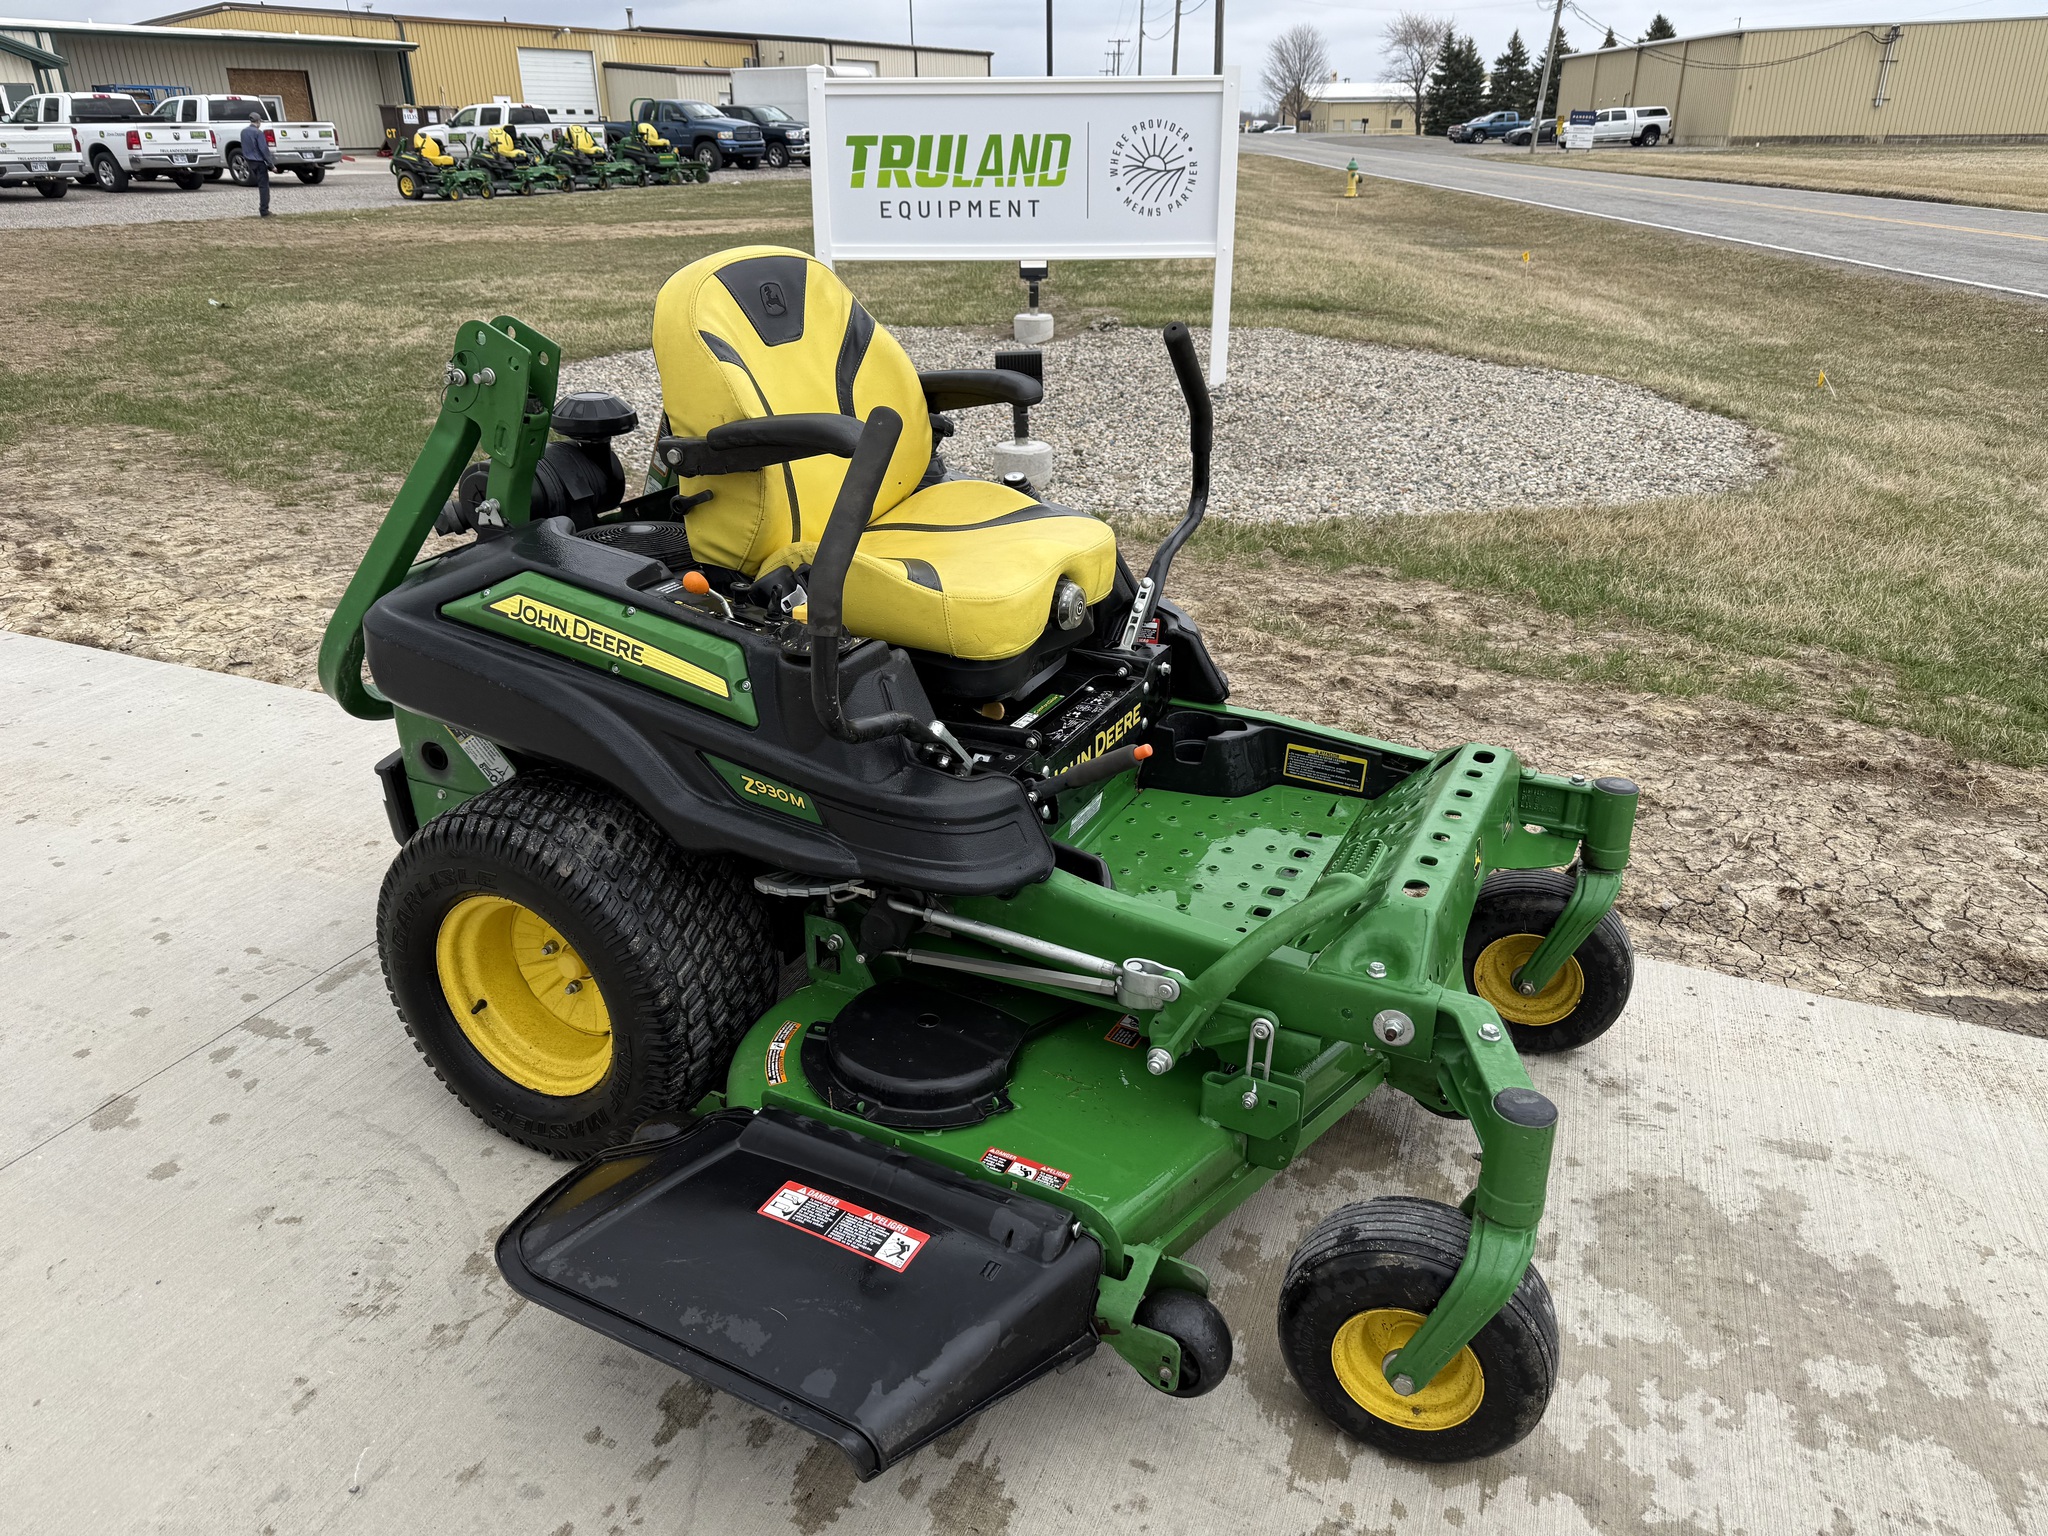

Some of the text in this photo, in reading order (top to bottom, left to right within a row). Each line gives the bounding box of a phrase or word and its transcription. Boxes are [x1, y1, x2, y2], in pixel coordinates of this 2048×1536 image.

[386, 128, 397, 138] CT
[845, 133, 1072, 188] TRULAND
[1109, 118, 1190, 177] WHERE PROVIDER
[880, 200, 1040, 220] EQUIPMENT
[1123, 161, 1198, 217] MEANS PARTNER
[510, 599, 645, 664] JOHN DEERE
[1095, 702, 1142, 758] DEERE
[391, 867, 498, 953] CARLISLE
[491, 1032, 633, 1140] TURF MASTER
[994, 1149, 1018, 1160] DANGER
[1045, 1167, 1071, 1179] PELIGRO
[806, 1189, 840, 1206] DANGER
[873, 1215, 909, 1234] PELIGRO
